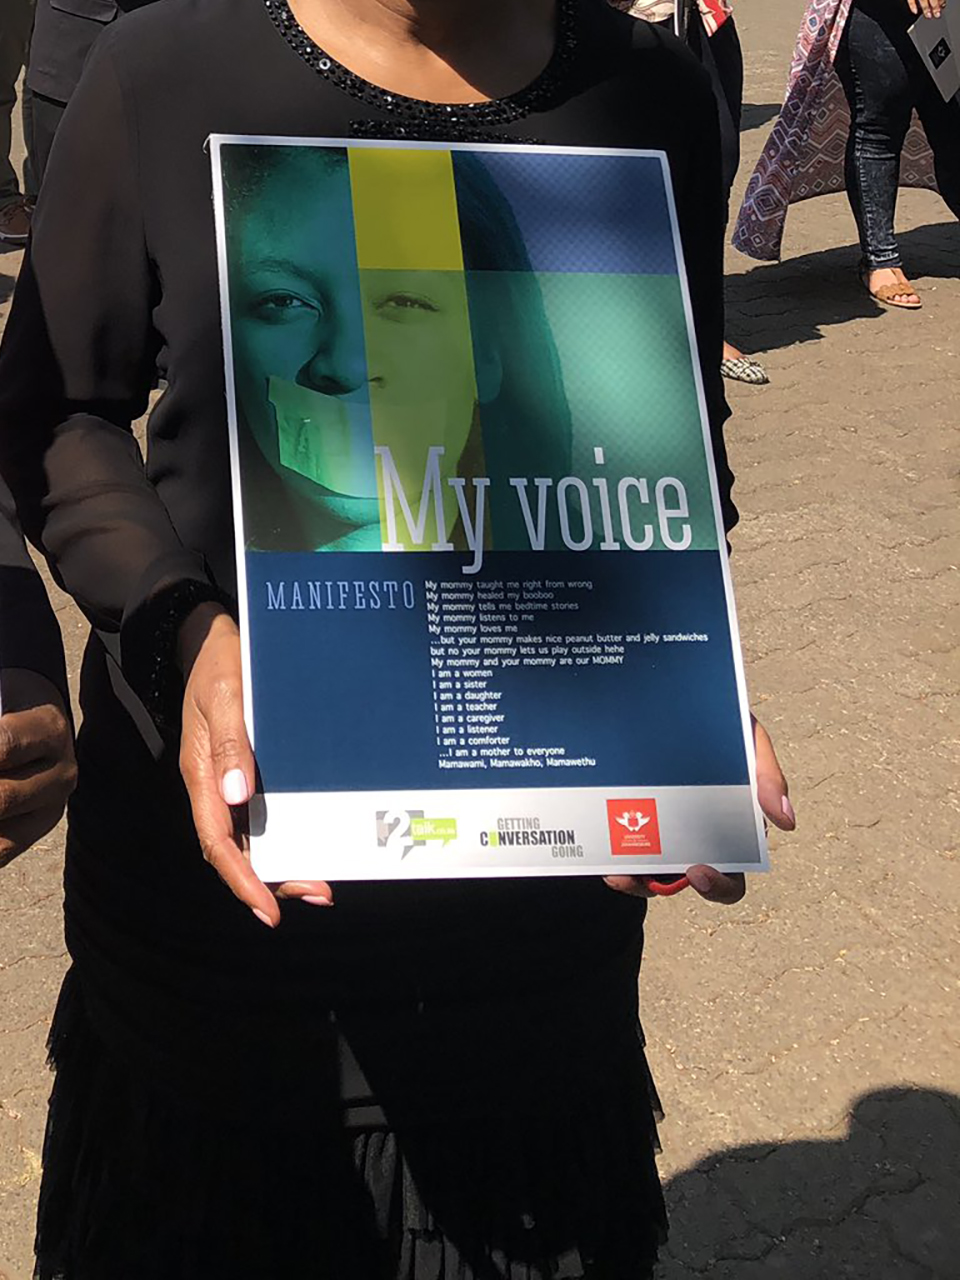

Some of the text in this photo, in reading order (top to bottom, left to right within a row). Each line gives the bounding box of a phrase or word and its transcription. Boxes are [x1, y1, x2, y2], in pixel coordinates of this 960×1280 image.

[374, 446, 692, 574] My voice
[424, 580, 437, 591] My
[440, 581, 473, 590] mommy
[476, 580, 503, 590] taught
[522, 580, 542, 590] right
[545, 579, 565, 588] from
[567, 580, 593, 590] wrong
[265, 580, 416, 610] MANIFESTO
[426, 602, 439, 613] My
[442, 603, 475, 612] mommy
[478, 601, 496, 611] tells
[514, 601, 548, 610] bedtime
[550, 602, 579, 610] stories
[457, 636, 477, 646] your
[479, 636, 513, 645] mommy
[515, 634, 543, 643] makes
[545, 635, 562, 643] nice
[565, 634, 594, 644] peanut
[596, 633, 622, 642] butter
[625, 633, 641, 642] and
[643, 633, 660, 644] jelly
[662, 632, 708, 642] sandwiches
[429, 644, 624, 657] but no your mommy lets us play outside hehe
[430, 657, 444, 669] My
[446, 658, 480, 668] mommy
[482, 657, 499, 666] and
[501, 658, 520, 668] your
[522, 657, 556, 667] mommy
[559, 657, 573, 665] are
[575, 657, 589, 665] our
[455, 748, 469, 757] am
[471, 748, 478, 757] a
[479, 746, 511, 756] mother
[513, 747, 524, 756] to
[526, 747, 565, 757] everyone
[497, 817, 540, 830] GETTING
[552, 845, 584, 858] GOING
